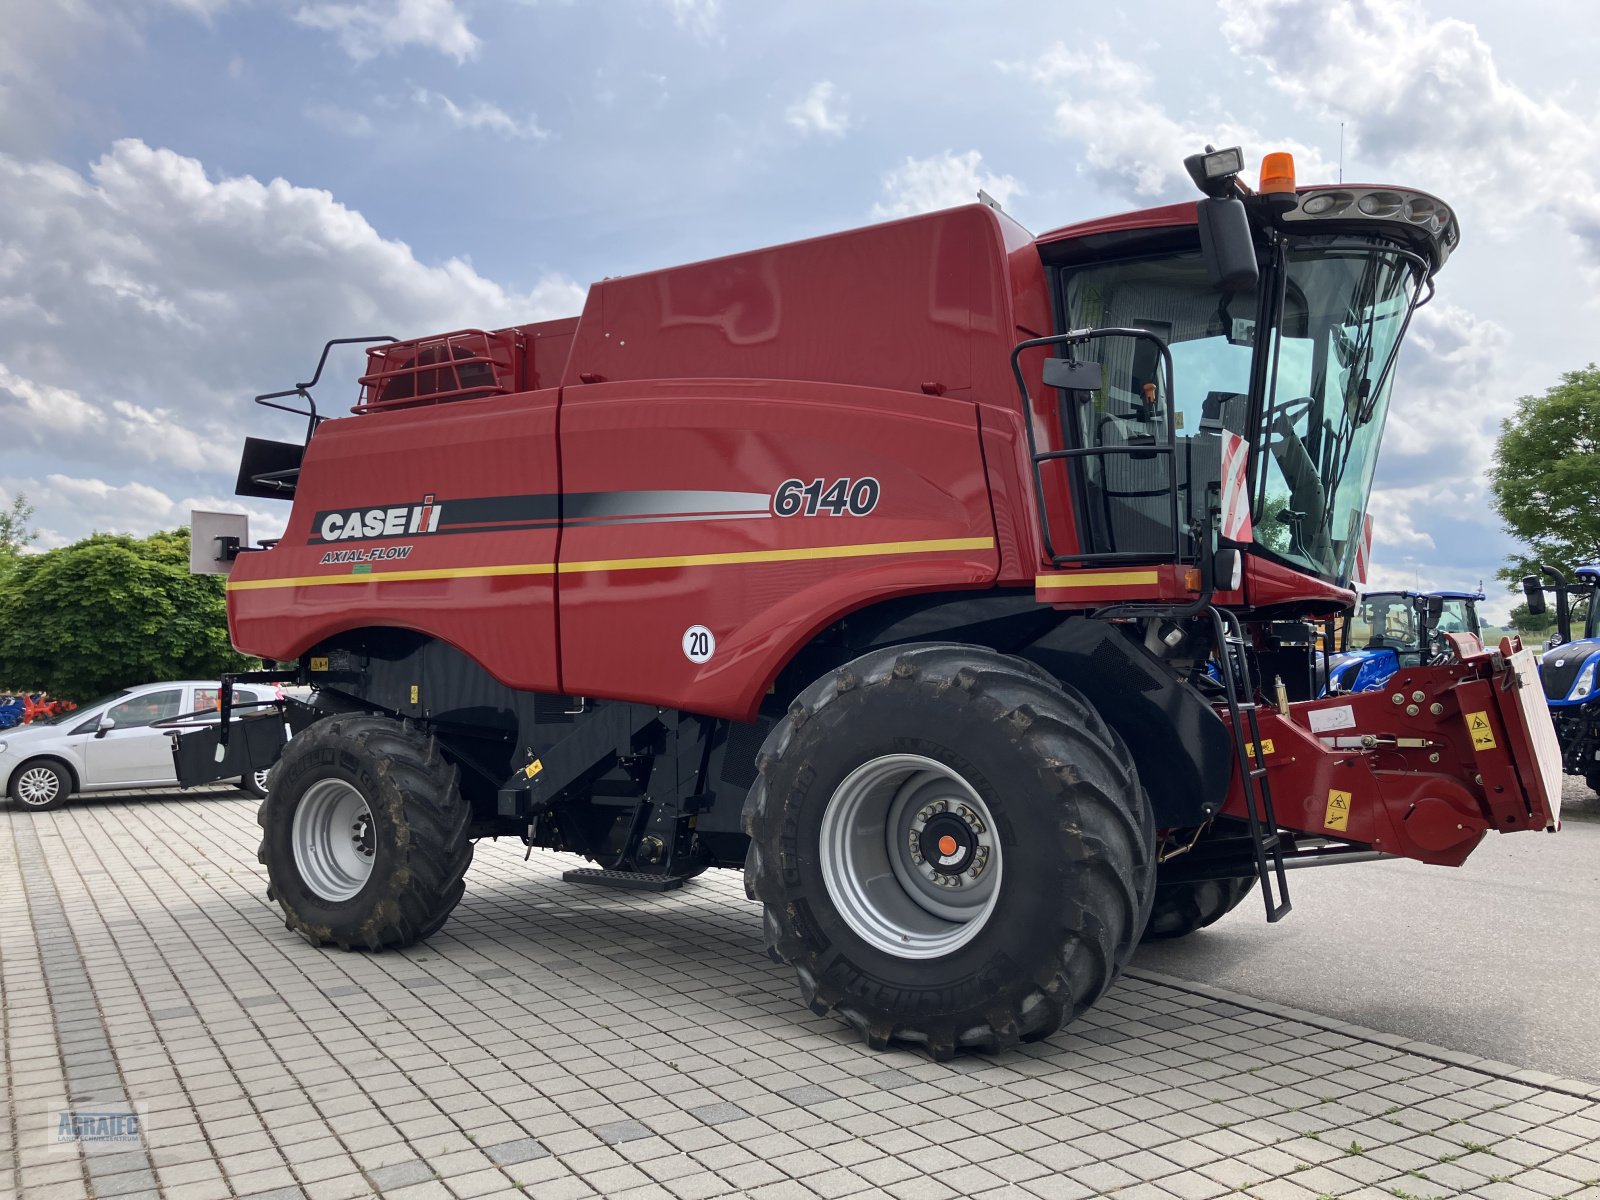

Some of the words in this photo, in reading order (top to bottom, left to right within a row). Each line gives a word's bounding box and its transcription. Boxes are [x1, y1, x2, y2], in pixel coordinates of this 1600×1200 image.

[773, 476, 880, 517] 6140
[320, 546, 413, 564] AXIAL-FLOW
[689, 632, 709, 656] 20
